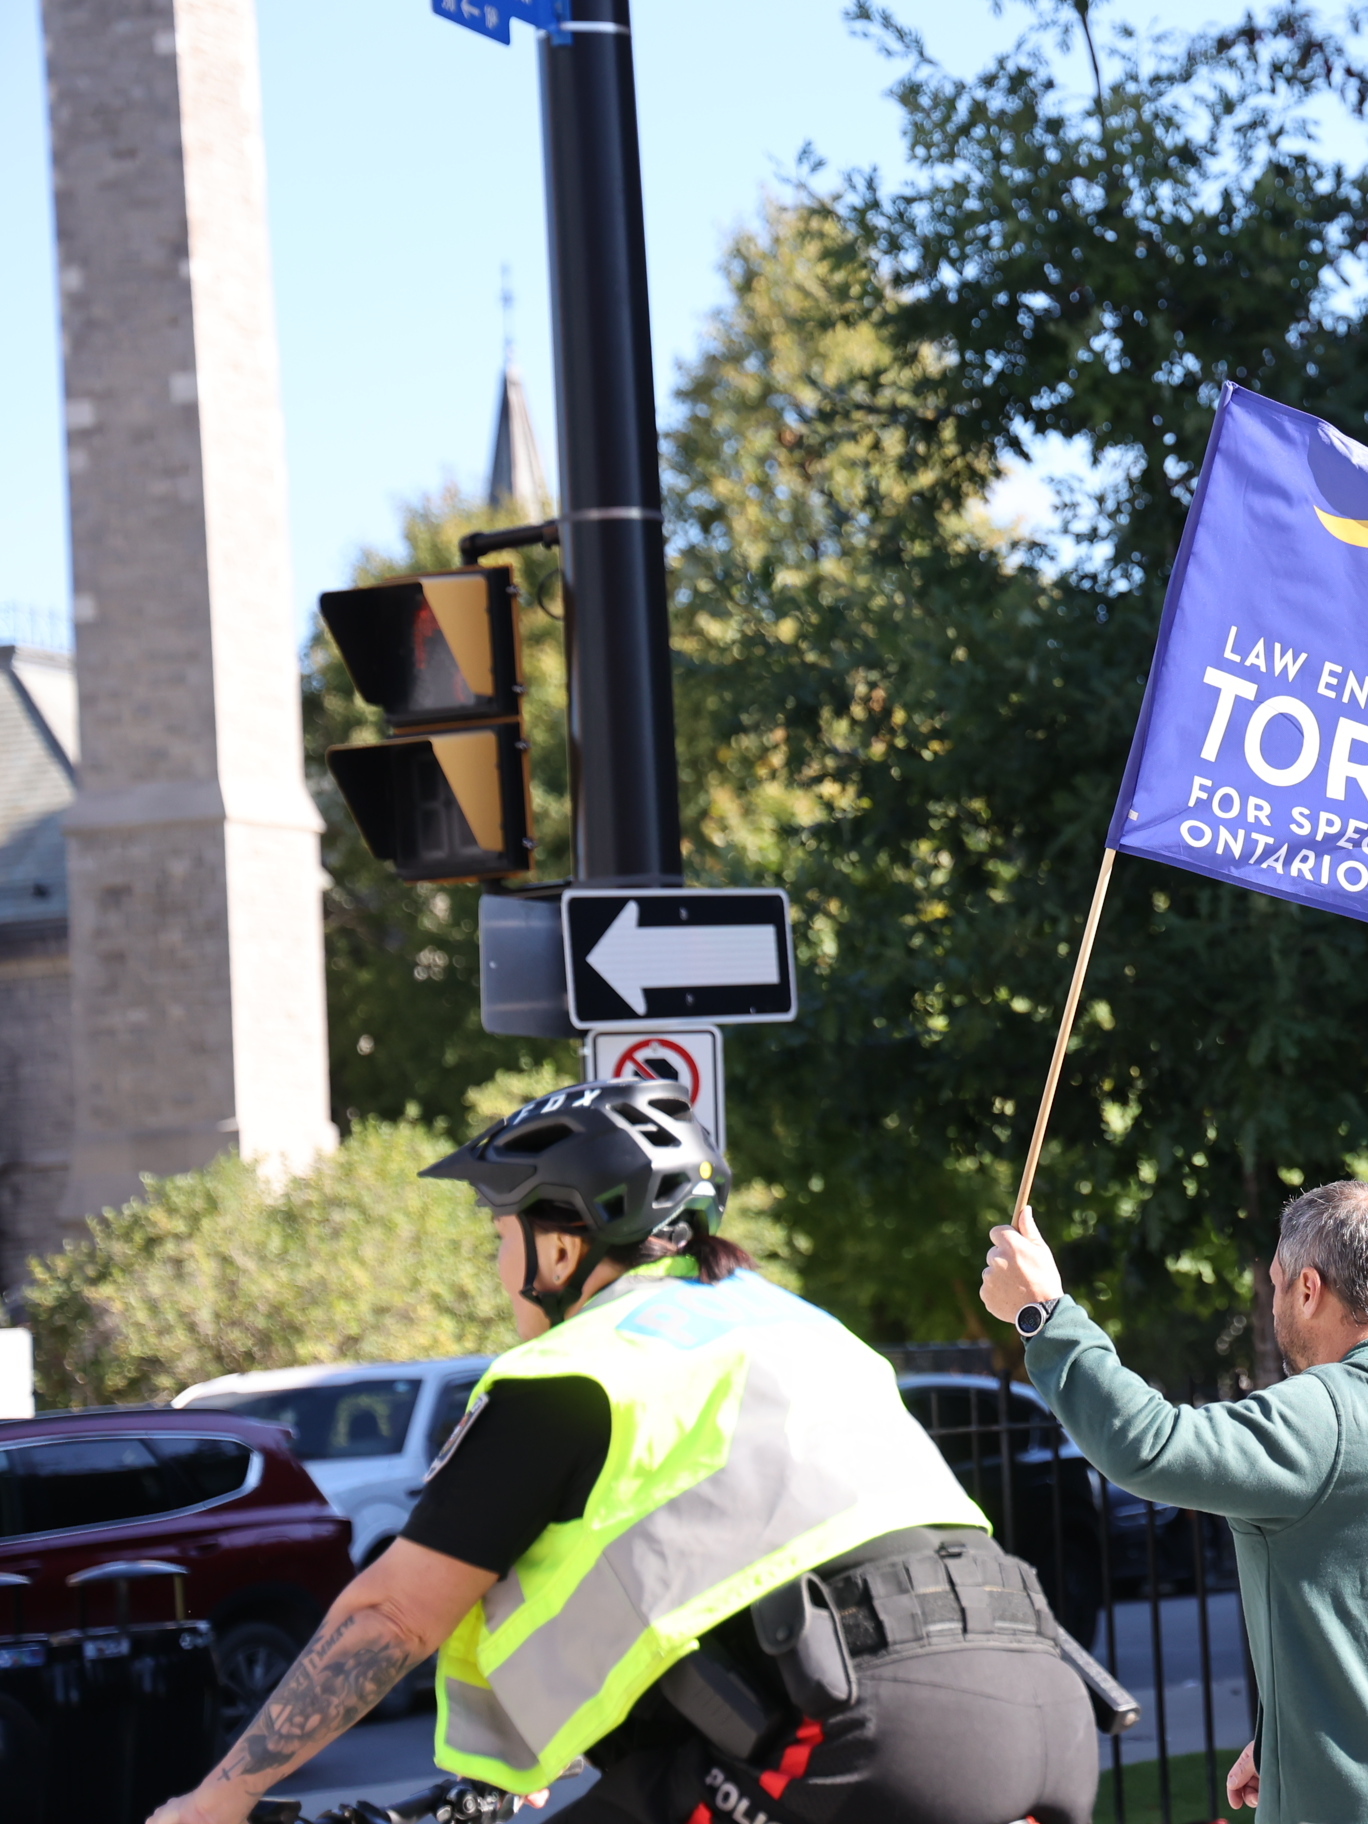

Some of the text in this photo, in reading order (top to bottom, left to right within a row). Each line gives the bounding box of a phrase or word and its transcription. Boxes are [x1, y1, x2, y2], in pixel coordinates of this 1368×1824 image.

[1223, 626, 1308, 681] LAW
[1188, 776, 1272, 827] FOR
[513, 1088, 602, 1125] FOX
